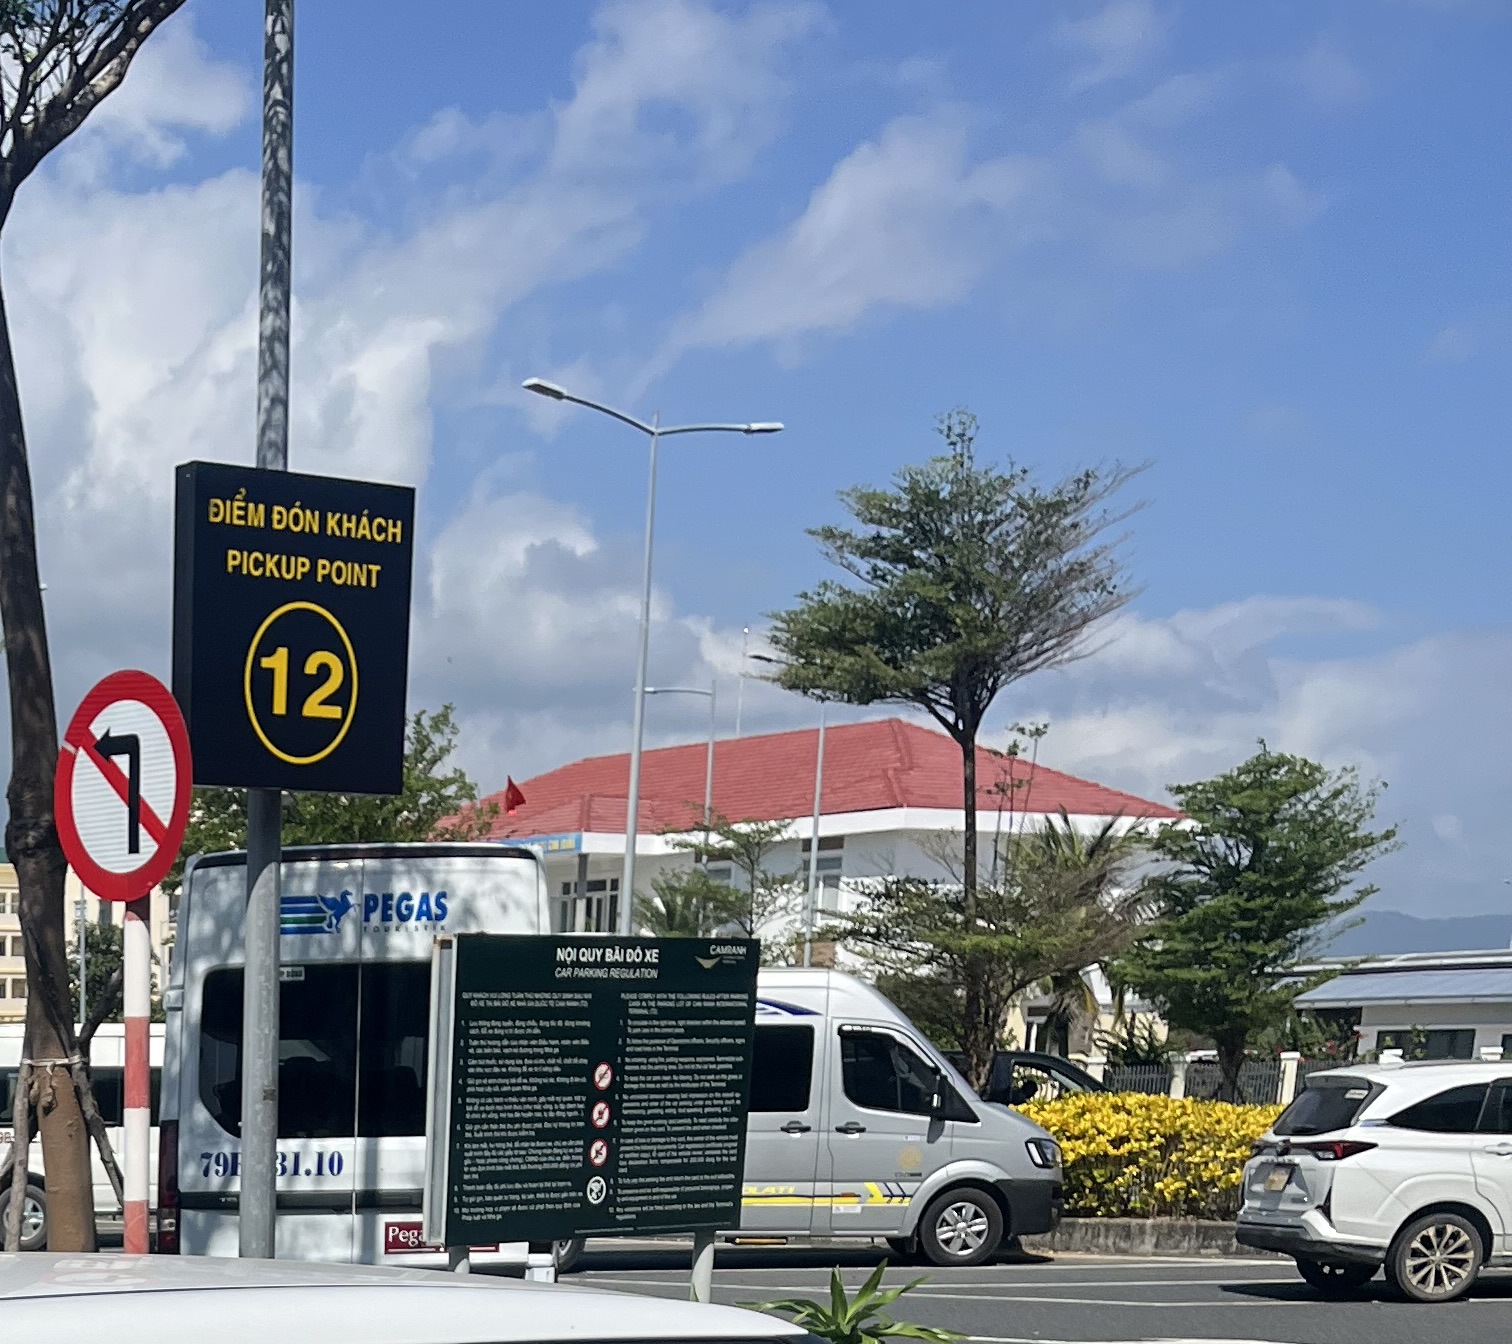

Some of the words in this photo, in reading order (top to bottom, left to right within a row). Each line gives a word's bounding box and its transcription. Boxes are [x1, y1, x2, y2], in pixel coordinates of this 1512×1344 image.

[208, 488, 265, 528] ĐIỂM
[272, 501, 320, 534] ĐÓN
[326, 509, 402, 543] KHÁCH
[227, 549, 311, 580] PICKUP
[317, 558, 381, 588] POINT
[260, 647, 344, 720] 12
[363, 890, 448, 922] PEGAS
[556, 946, 577, 964] NỘI
[578, 947, 603, 962] QUY
[605, 945, 624, 962] BÃI
[644, 948, 659, 963] XE
[554, 966, 572, 978] CAR
[573, 967, 608, 979] PARKING
[609, 967, 658, 979] REGULATION
